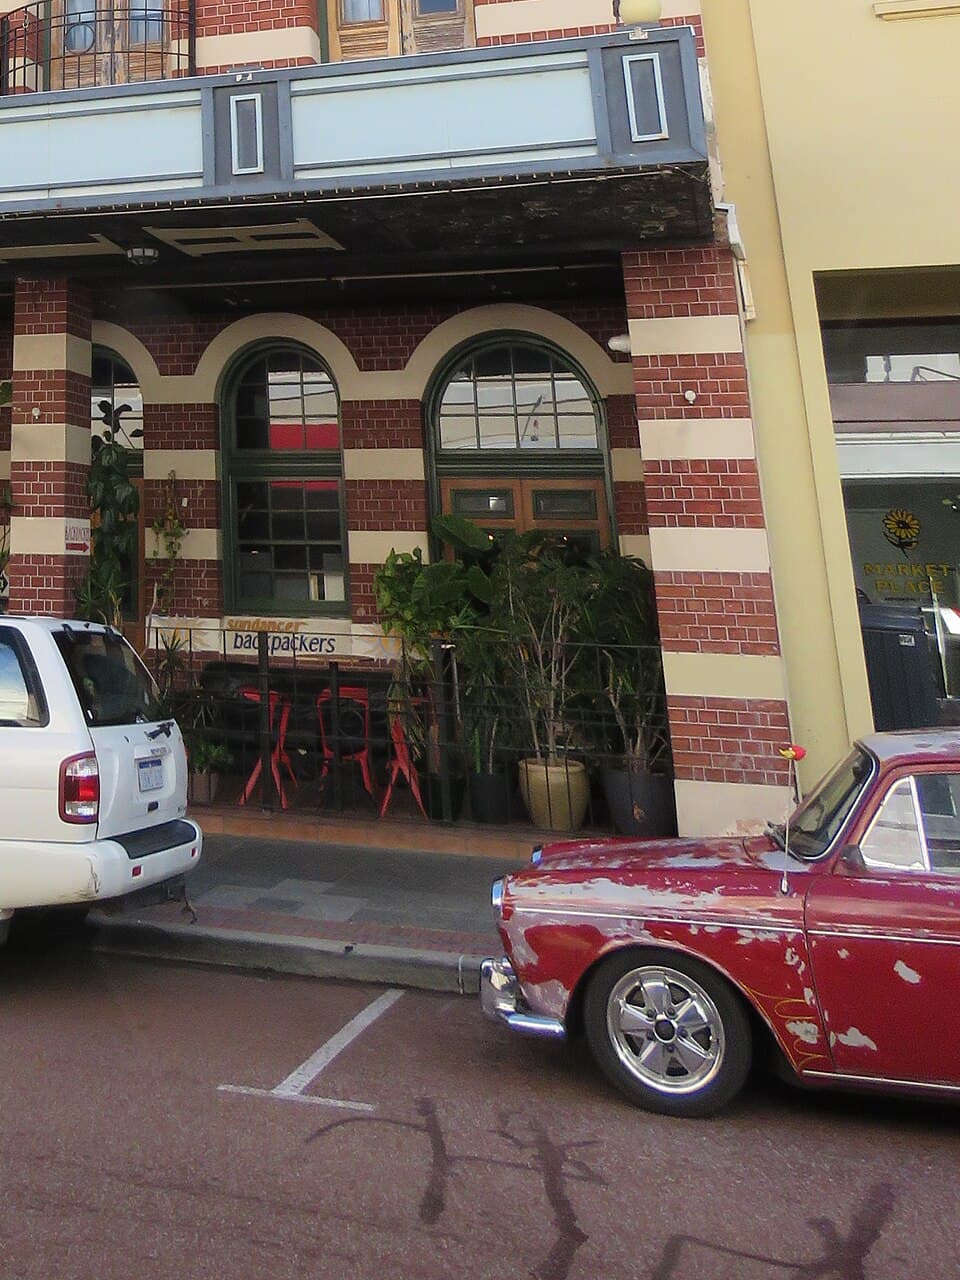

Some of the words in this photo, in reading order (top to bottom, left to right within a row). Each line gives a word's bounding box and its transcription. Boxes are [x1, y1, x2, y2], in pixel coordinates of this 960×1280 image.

[863, 563, 950, 577] MARKET
[875, 580, 945, 593] PLACE
[233, 632, 336, 654] bacpackers
